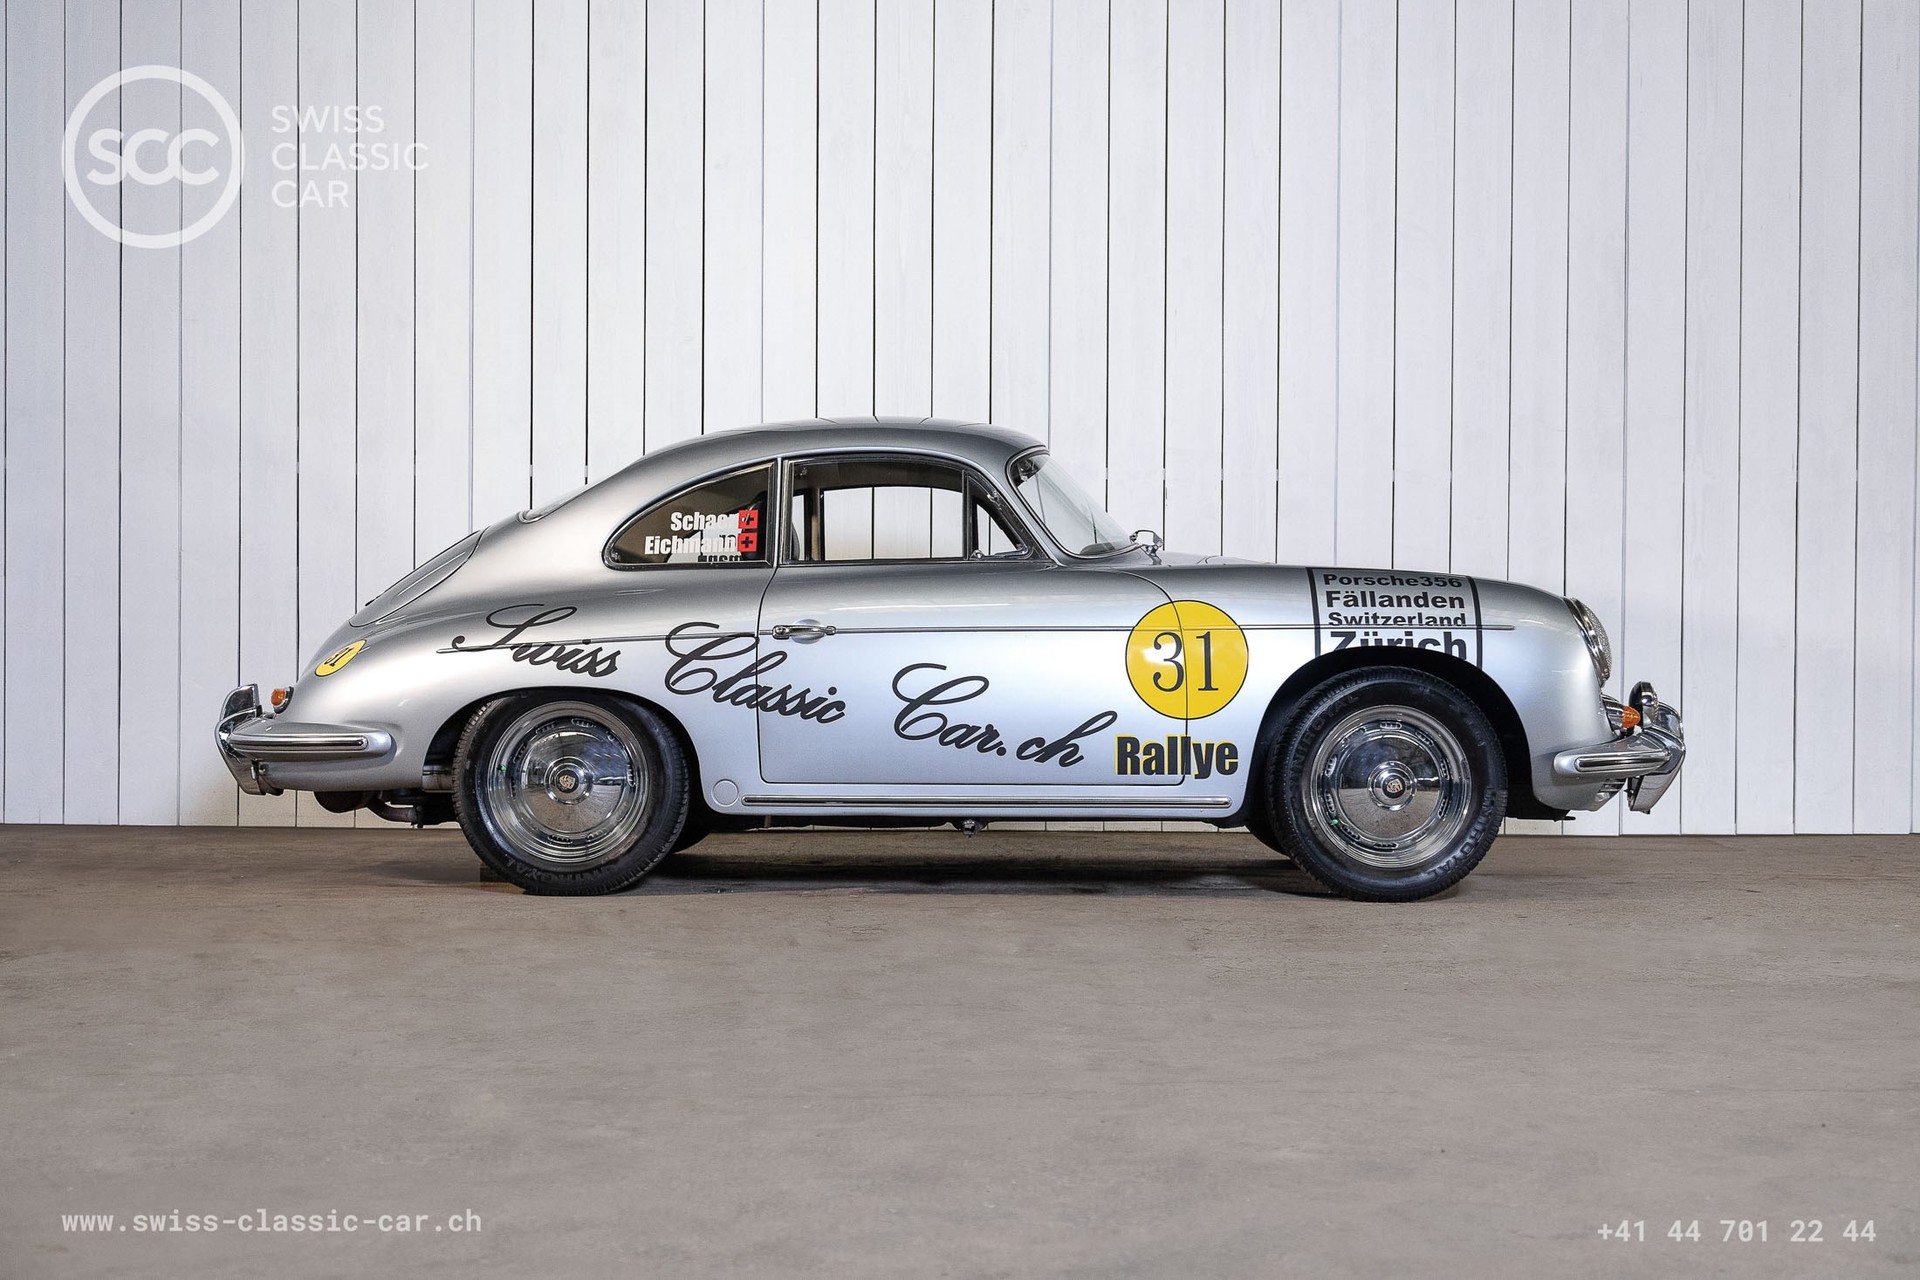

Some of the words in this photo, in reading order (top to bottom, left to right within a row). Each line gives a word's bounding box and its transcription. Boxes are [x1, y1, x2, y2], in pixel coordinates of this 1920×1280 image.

[644, 533, 737, 555] Eichmann
[1323, 574, 1462, 588] Porsche356
[1325, 590, 1465, 608] Fällanden
[1328, 612, 1467, 627] Switzerland
[665, 621, 847, 724] Classic
[1153, 631, 1219, 692] 31
[1115, 734, 1239, 780] Rallye
